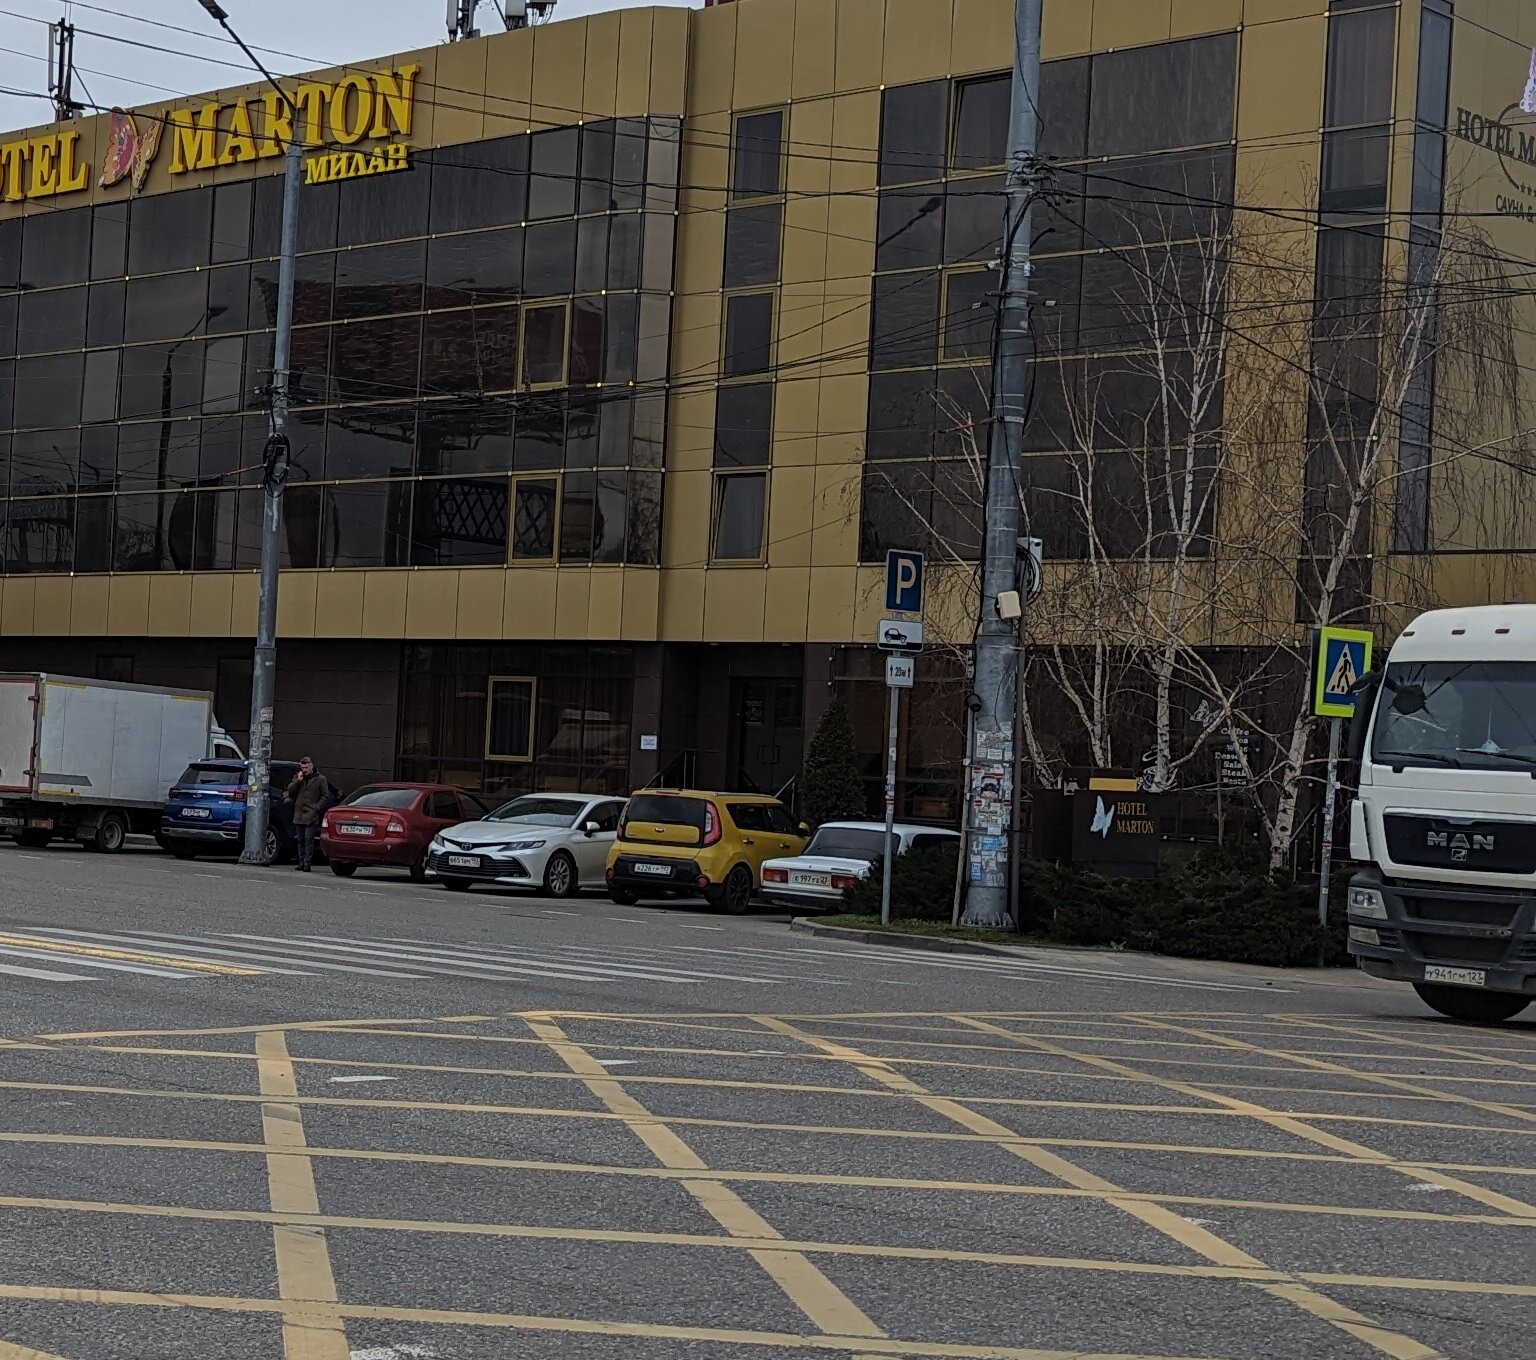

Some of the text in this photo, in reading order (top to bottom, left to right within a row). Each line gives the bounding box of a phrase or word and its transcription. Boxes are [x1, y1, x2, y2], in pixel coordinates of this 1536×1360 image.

[168, 63, 421, 174] MARTON
[1456, 106, 1515, 157] HOTEL
[304, 142, 409, 185] МИЛАН
[1495, 194, 1525, 221] САУНА
[895, 557, 917, 605] P
[1116, 801, 1148, 816] HOTEL
[1116, 820, 1155, 834] MARTON
[1427, 831, 1495, 851] MAN
